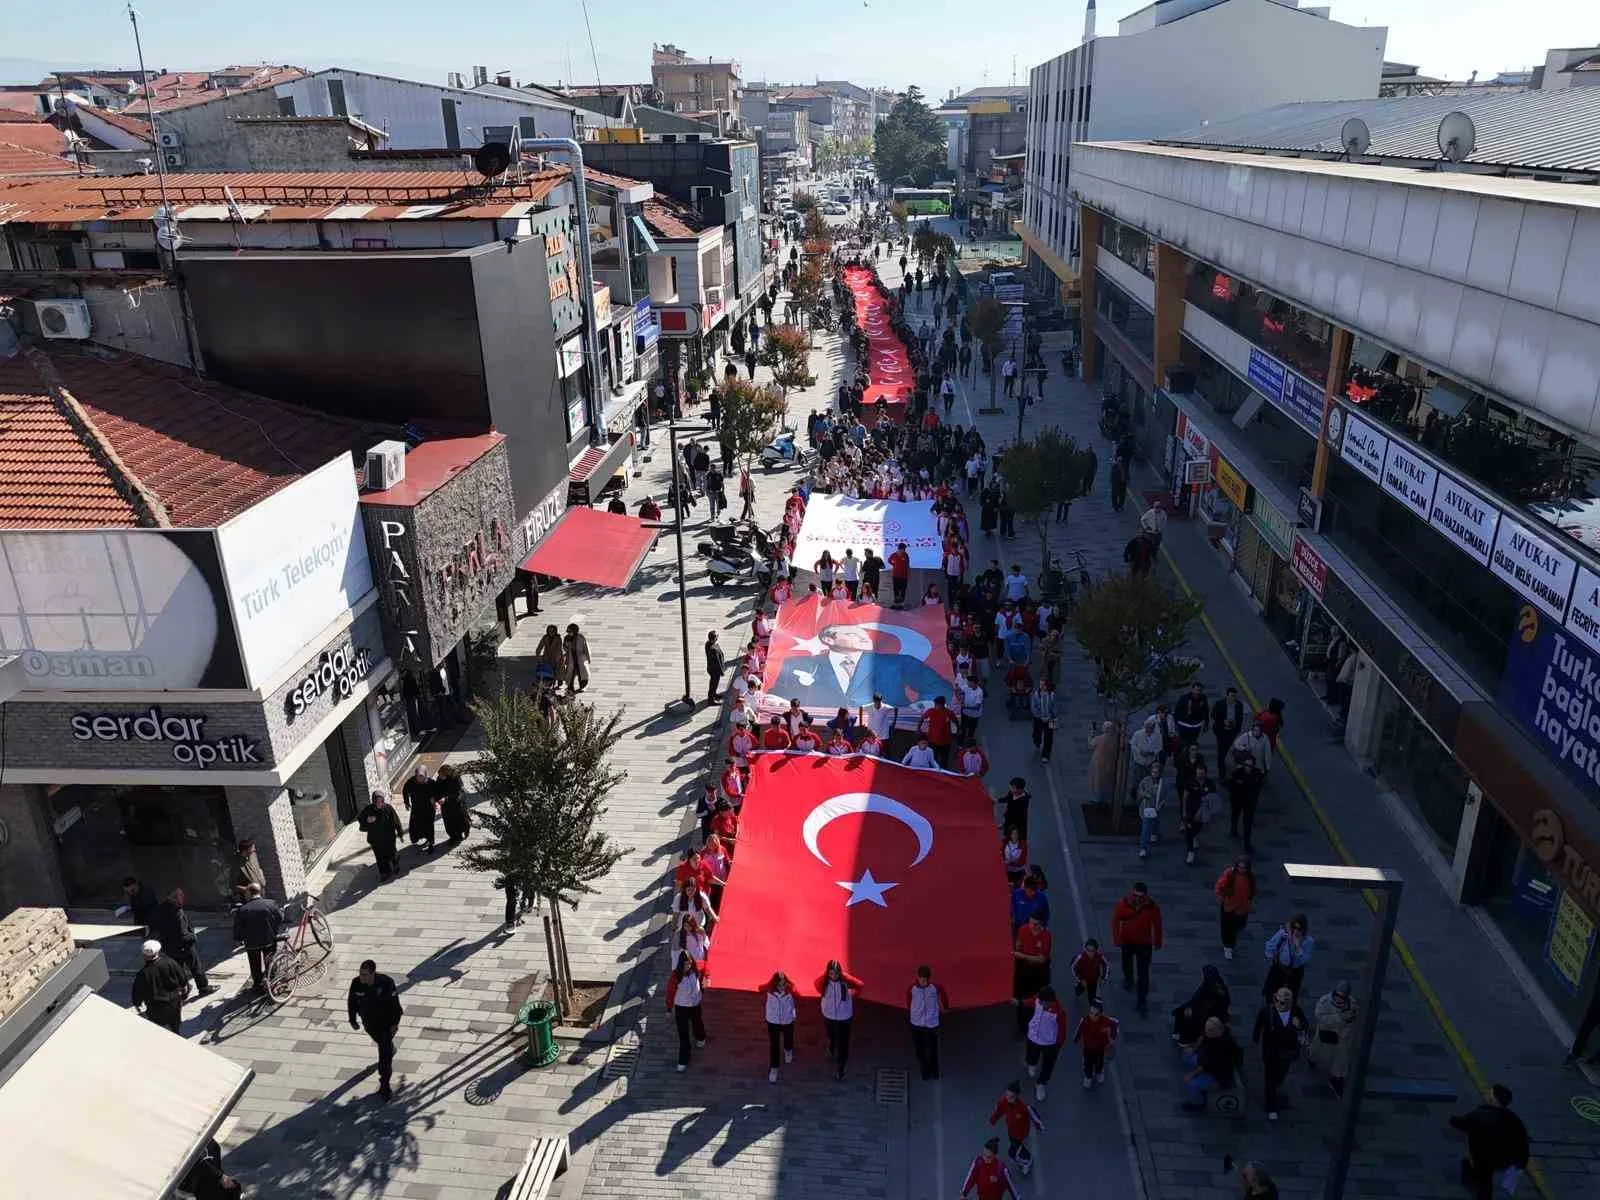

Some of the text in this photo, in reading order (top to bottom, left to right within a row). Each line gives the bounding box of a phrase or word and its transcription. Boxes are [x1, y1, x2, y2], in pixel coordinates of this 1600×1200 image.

[1392, 454, 1426, 484] AVUKAT
[1386, 468, 1427, 511] İSMAİL CAN
[1445, 489, 1486, 526] AVUKAT
[1509, 532, 1561, 577] AVUKAT
[241, 529, 346, 621] Türk Telekom
[24, 651, 155, 677] Osman
[292, 643, 350, 715] serdar
[340, 649, 377, 695] optik
[71, 708, 204, 741] serdar
[173, 737, 259, 768] optik
